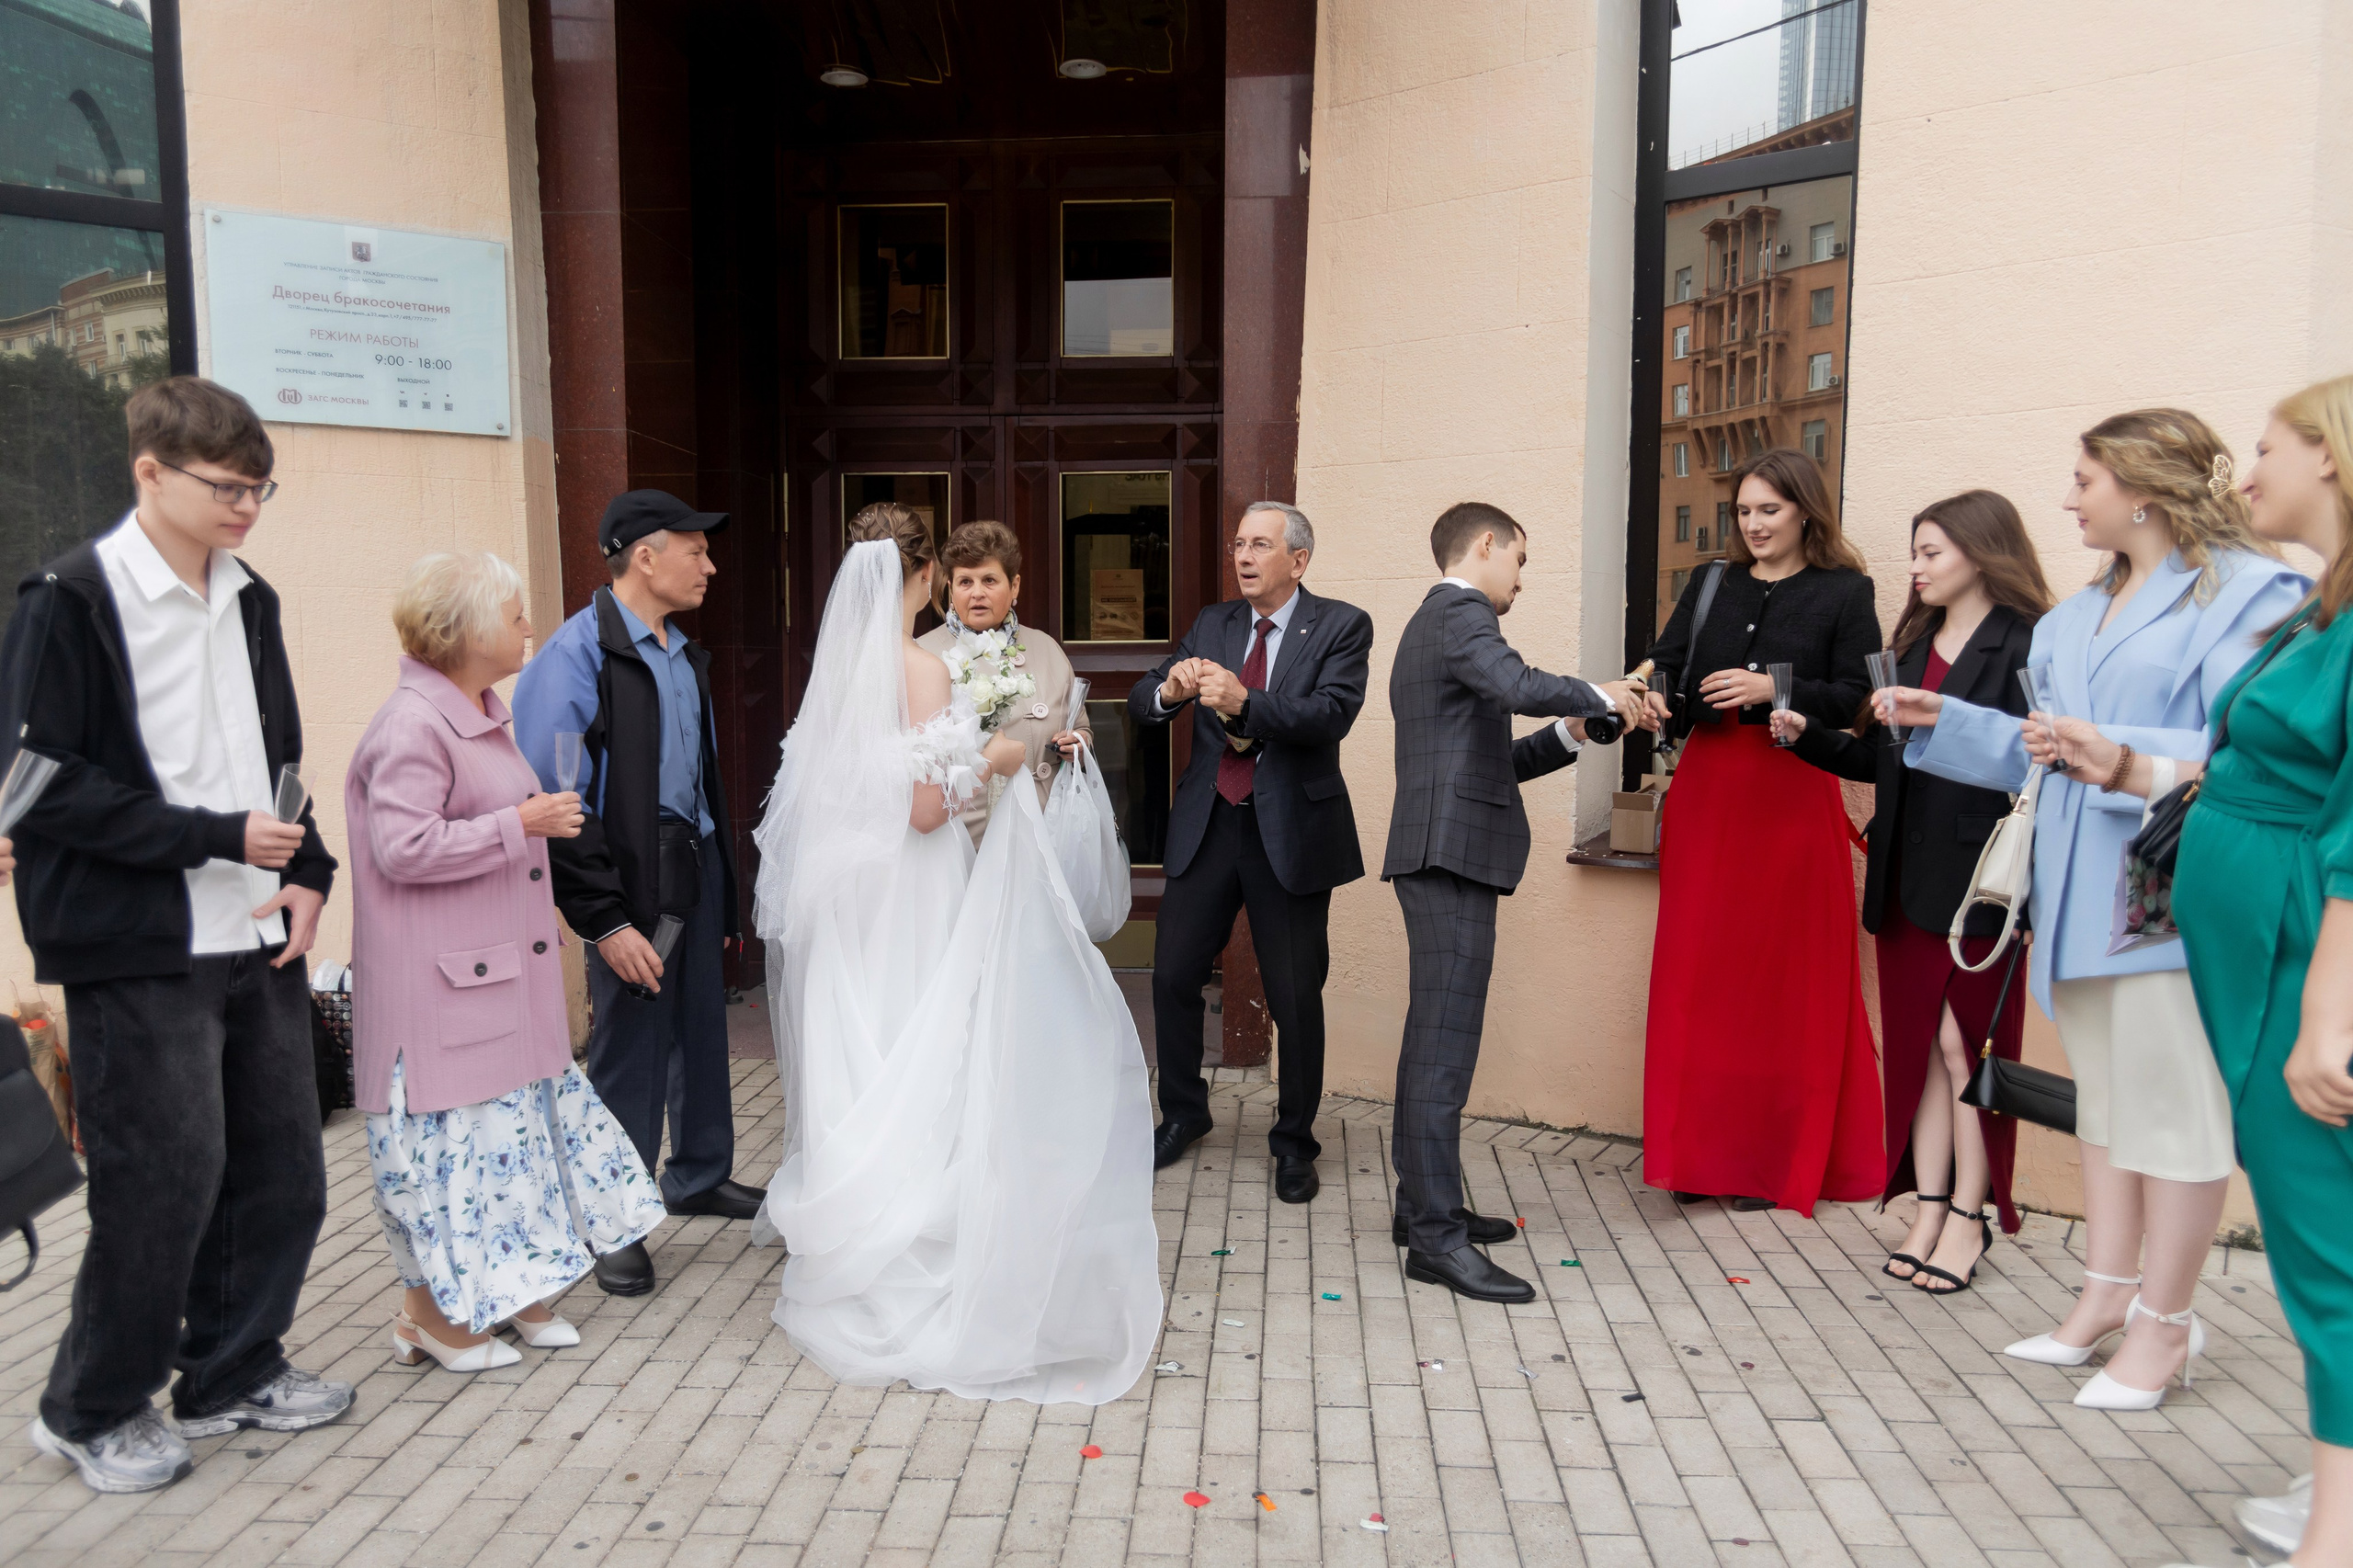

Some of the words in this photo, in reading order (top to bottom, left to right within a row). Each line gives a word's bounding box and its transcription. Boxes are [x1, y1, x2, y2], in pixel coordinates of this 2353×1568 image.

[283, 261, 318, 270] УПРАВЛЕНИЕ
[319, 265, 343, 273] ЗАПИСИ
[363, 269, 405, 278] ГРАЖДАНСКОГО
[272, 285, 330, 304] Дворец
[334, 290, 451, 314] бракосочетания
[310, 328, 362, 344] РЕЖИМ
[366, 333, 419, 348] РАБОТЫ
[275, 348, 302, 357] ВТОРНИК
[374, 353, 405, 367] 9:00
[418, 357, 452, 370] 18:00
[275, 367, 317, 376] ВОСКРЕСЕНЬЕ
[321, 370, 365, 380] ПОНЕДЕЛЬНИК
[397, 376, 430, 385] ВЫХОДНОЙ
[308, 394, 329, 403] ЗАГС
[330, 396, 369, 405] МОСКВЫ
